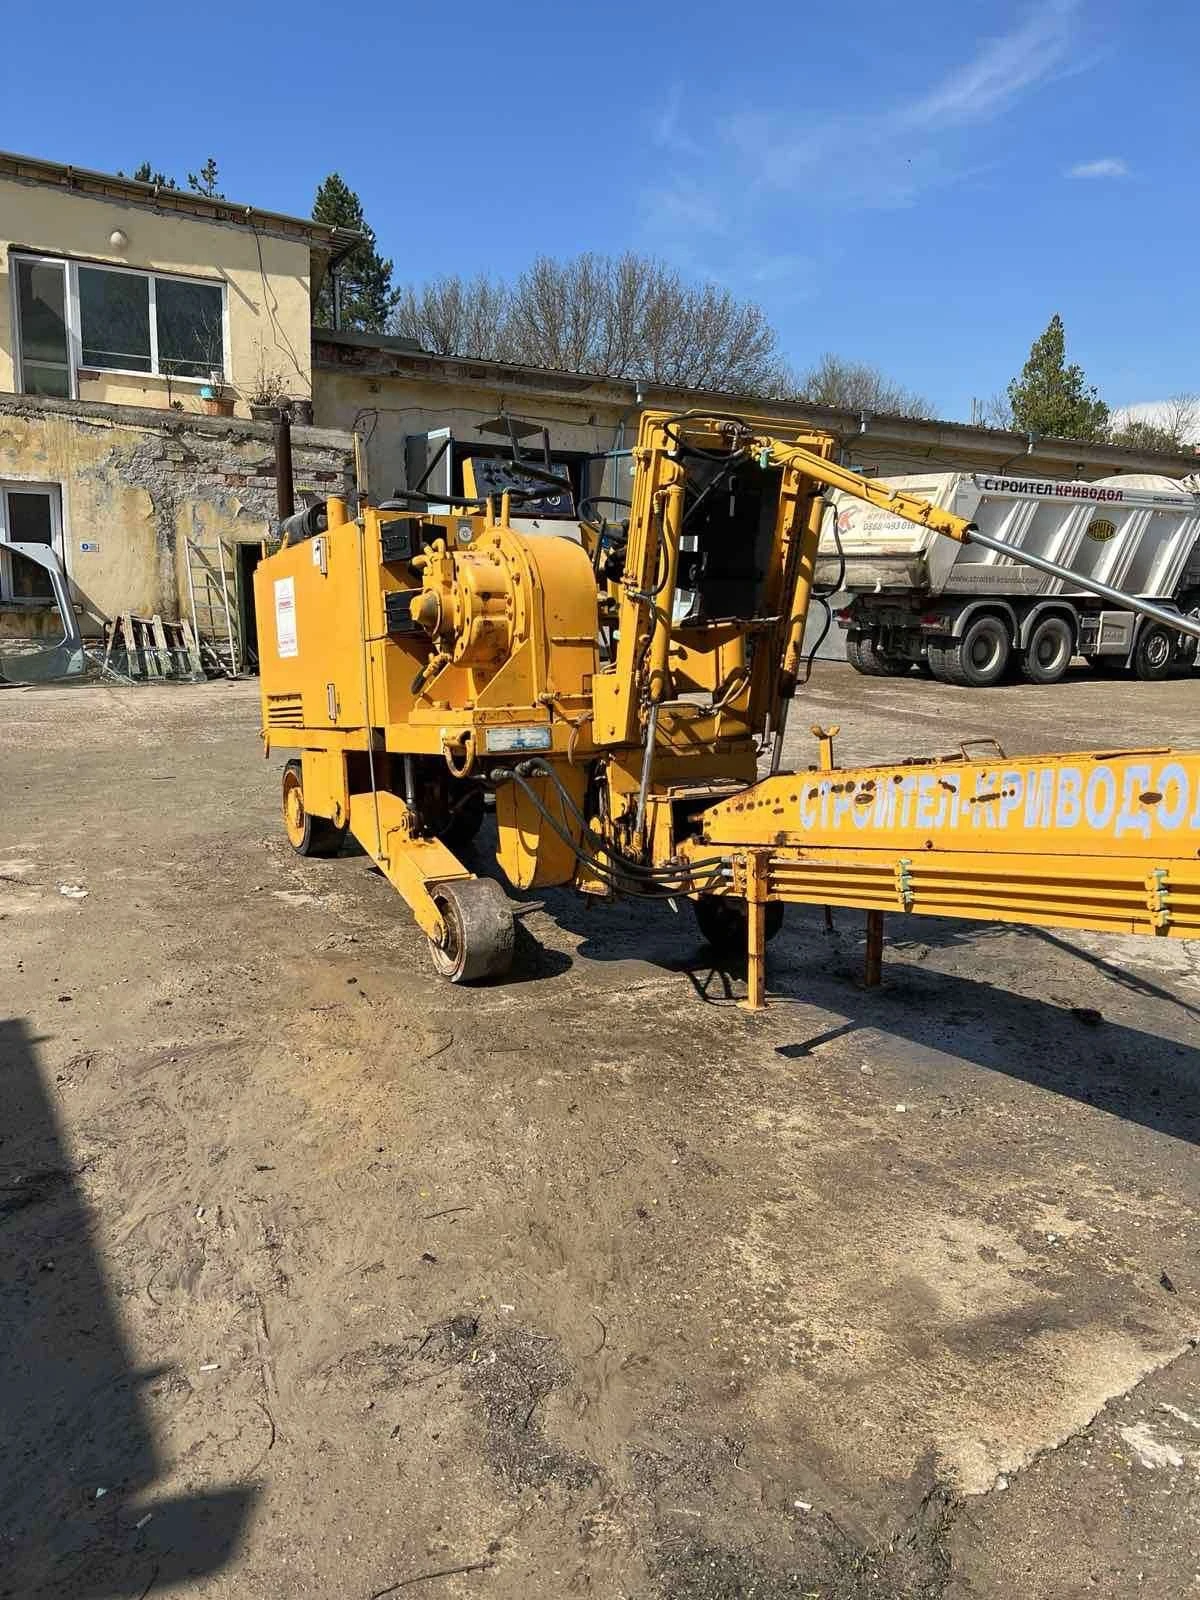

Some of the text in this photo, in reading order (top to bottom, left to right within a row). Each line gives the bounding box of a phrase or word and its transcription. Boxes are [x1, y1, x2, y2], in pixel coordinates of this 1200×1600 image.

[984, 479, 1124, 501] СТРОИТЕЛ КРИВОДОЛ
[800, 762, 1200, 839] СТРОИТЕЛ-КРИВОДО
